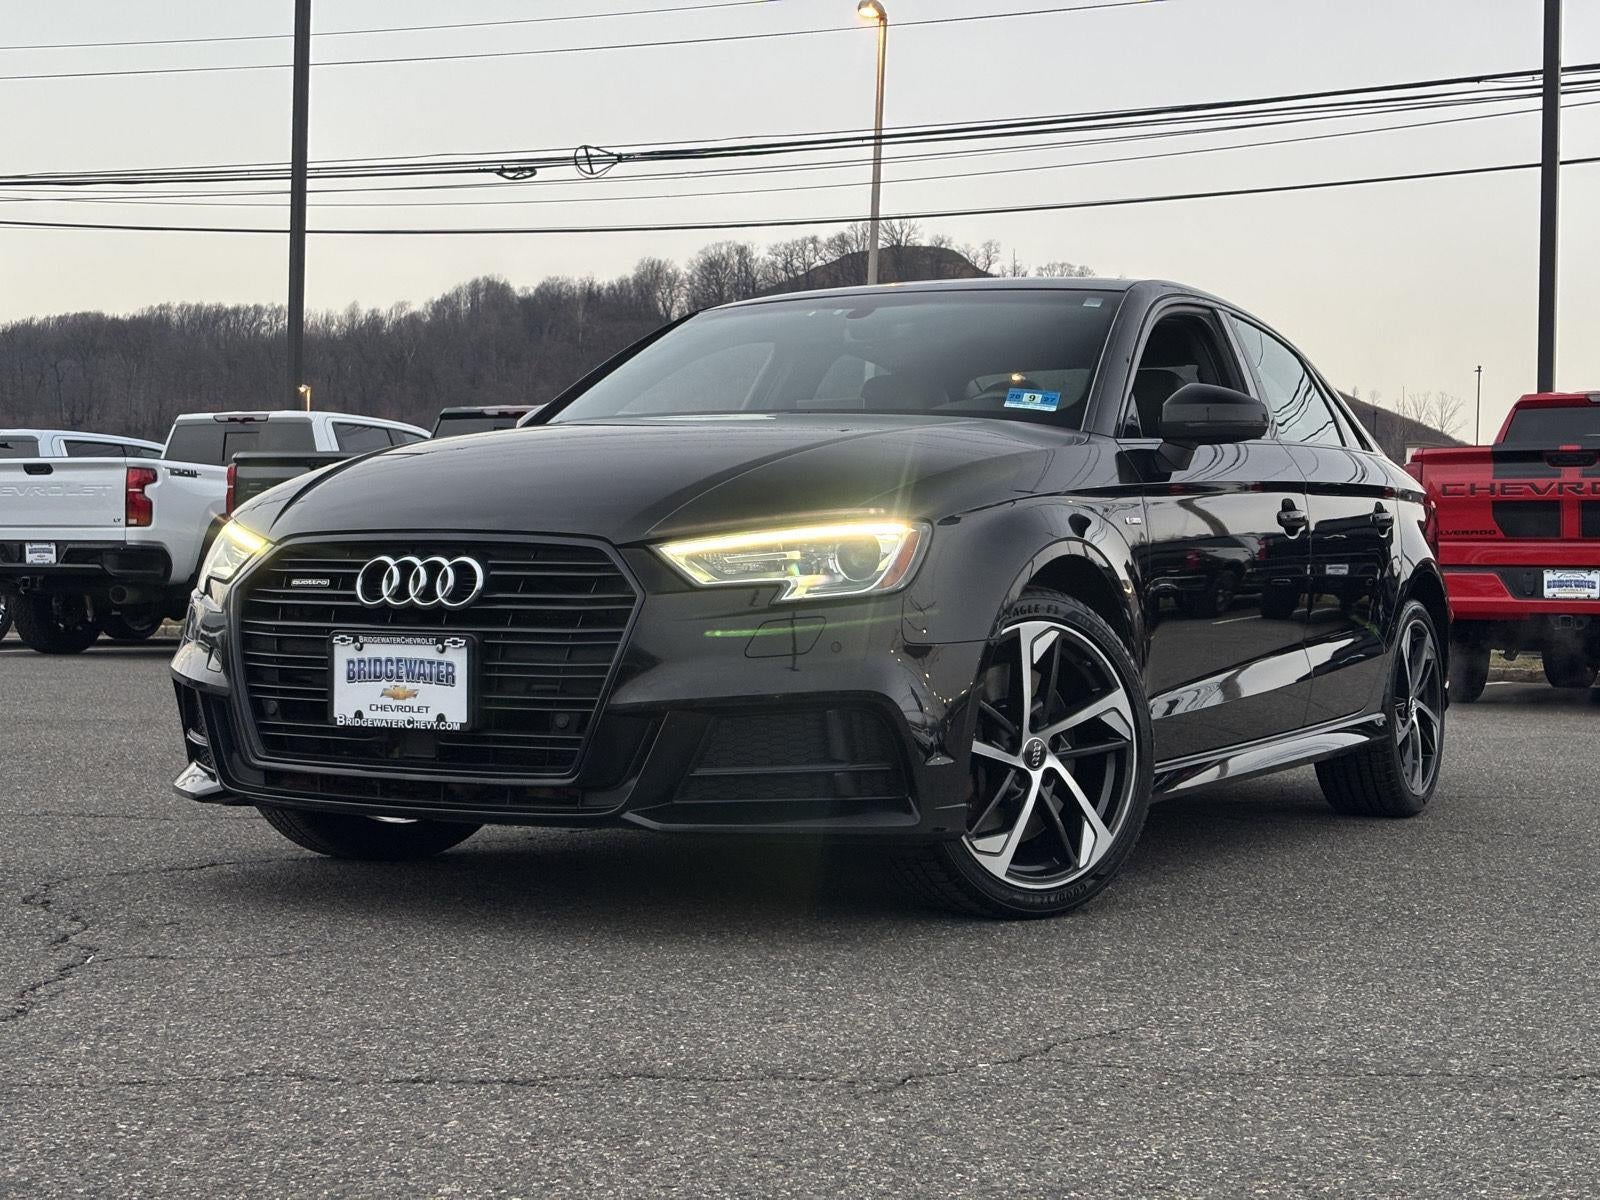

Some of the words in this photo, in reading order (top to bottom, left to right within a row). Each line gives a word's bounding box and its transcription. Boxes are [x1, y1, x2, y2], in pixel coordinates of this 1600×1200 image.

[1028, 394, 1036, 402] 9
[346, 655, 456, 688] BRIDGEWATER
[369, 703, 431, 714] CHEVROLET
